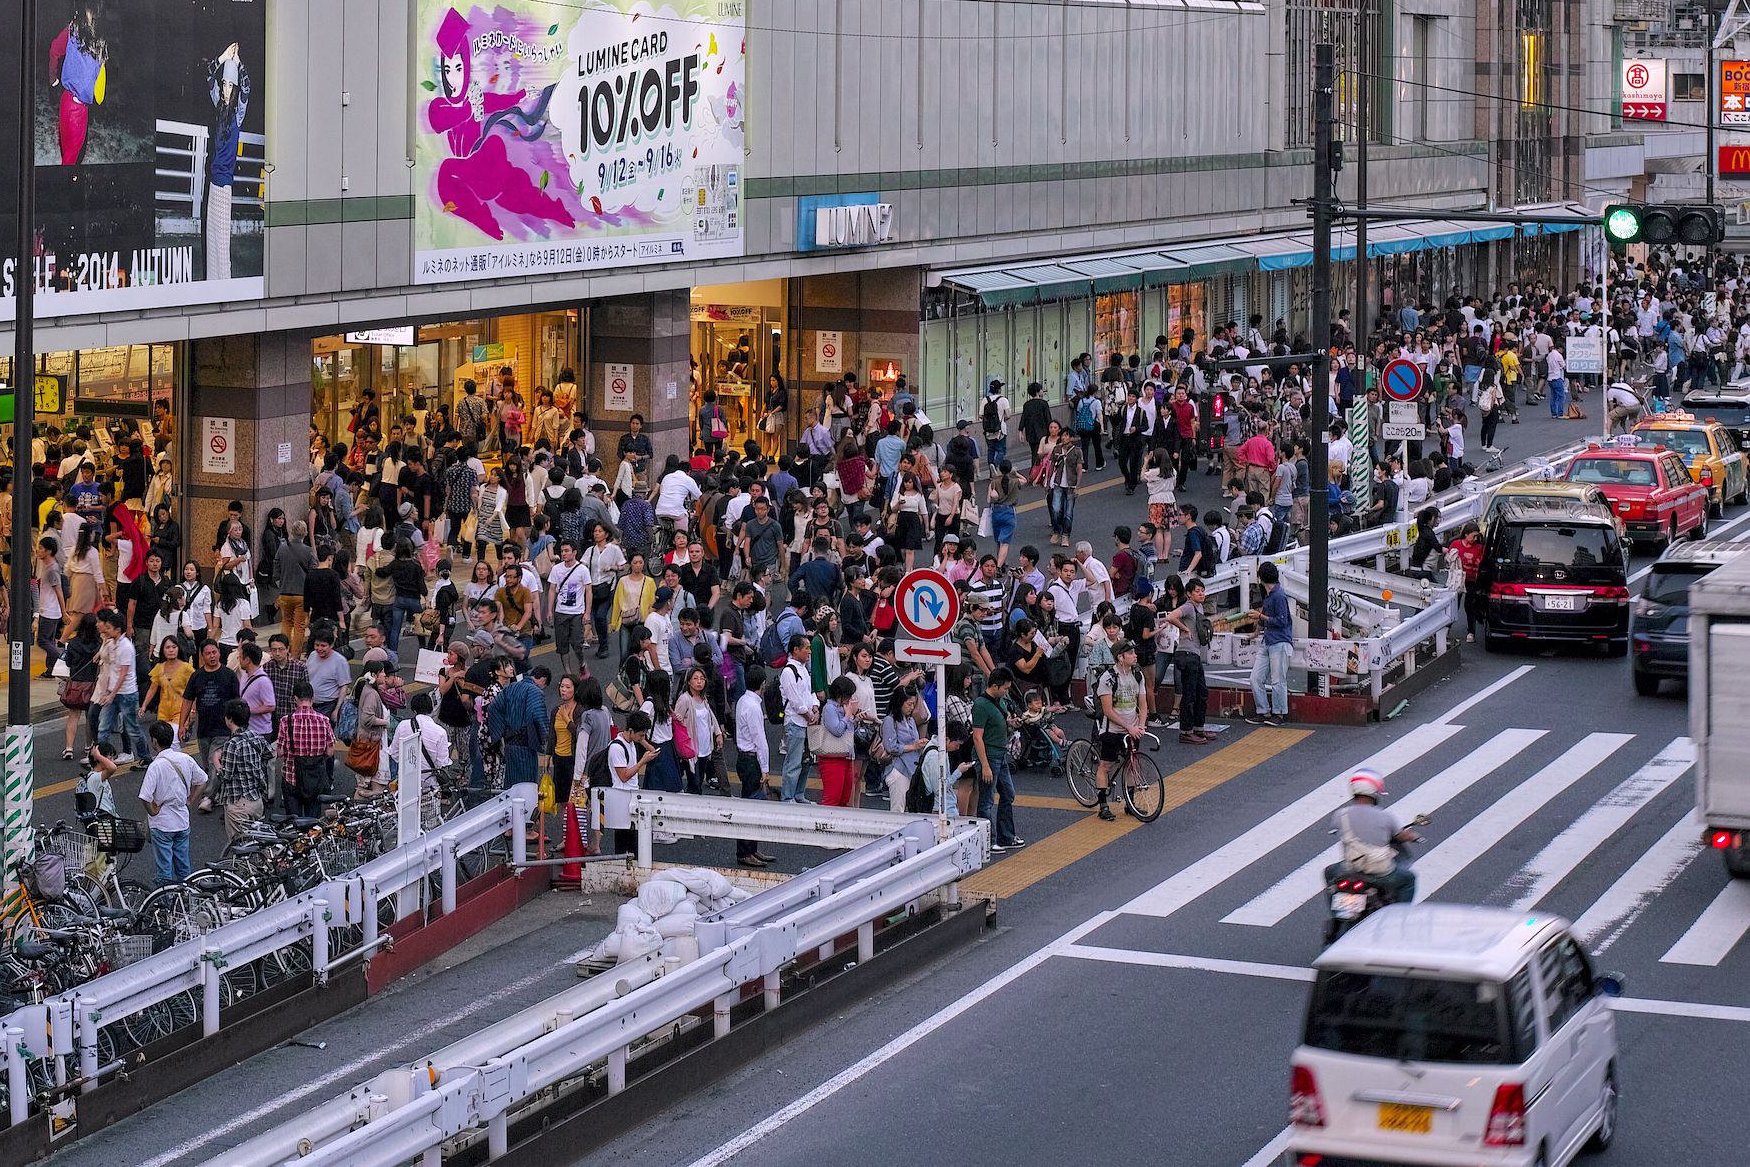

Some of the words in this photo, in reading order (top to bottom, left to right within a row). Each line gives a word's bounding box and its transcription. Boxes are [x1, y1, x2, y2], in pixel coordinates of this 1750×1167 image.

[717, 1, 741, 17] LUMINE
[577, 41, 628, 76] LUMINE
[631, 30, 668, 61] CARD
[577, 54, 698, 154] 10%OFF
[1723, 94, 1743, 110] 本
[818, 204, 886, 246] LUMINE
[2, 255, 56, 297] SLE
[77, 251, 120, 291] 2014
[130, 246, 193, 288] AUTUMN
